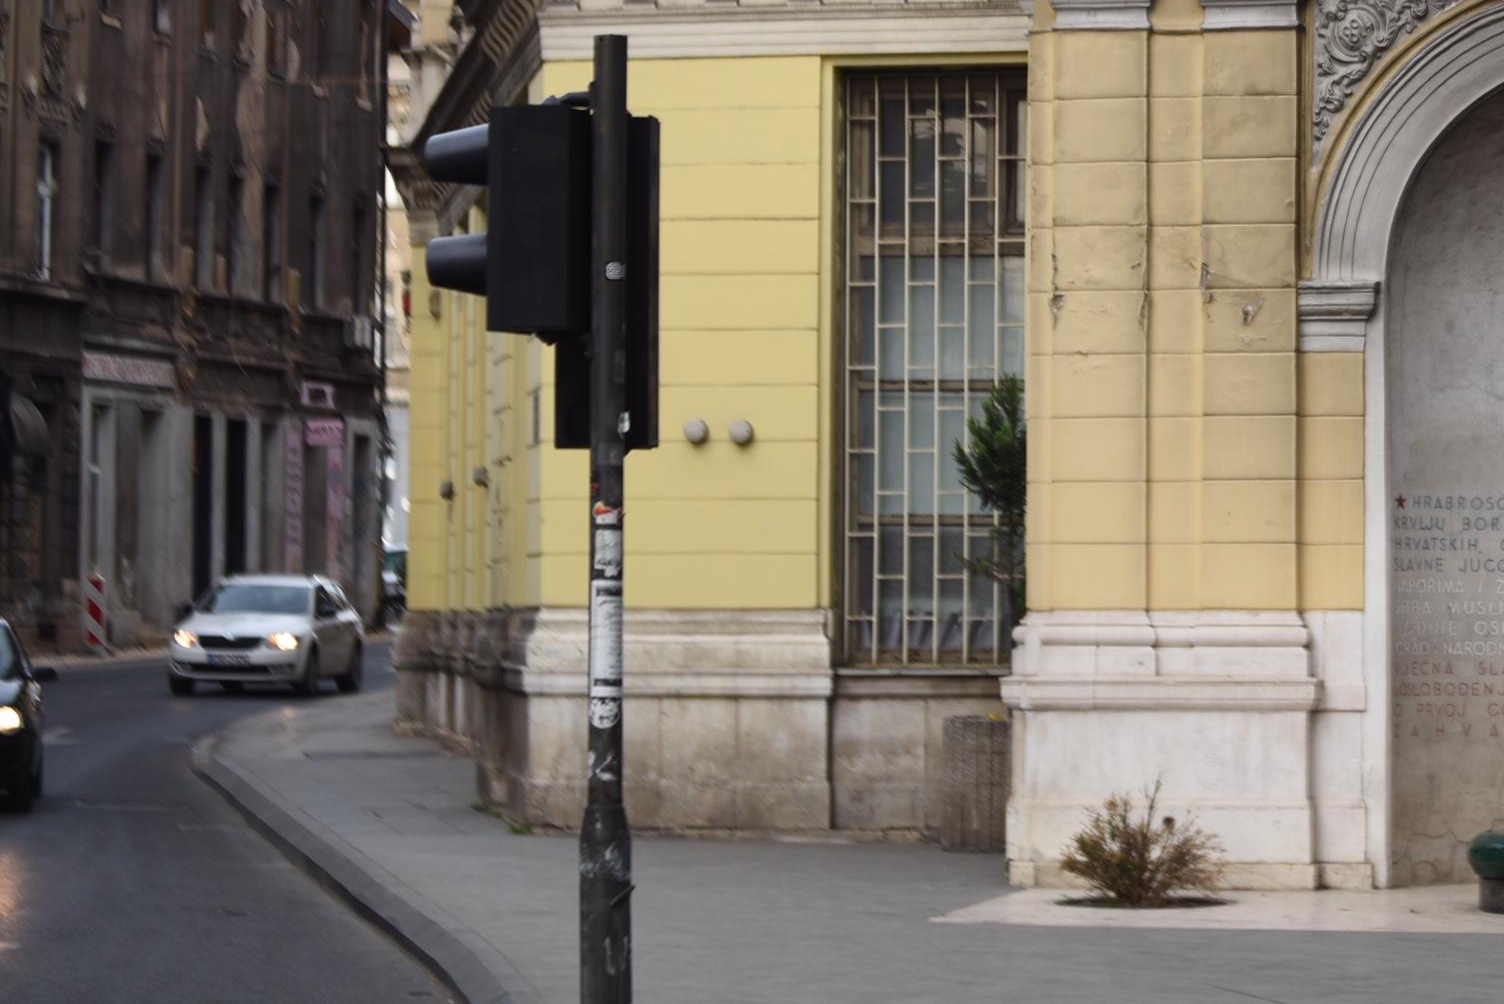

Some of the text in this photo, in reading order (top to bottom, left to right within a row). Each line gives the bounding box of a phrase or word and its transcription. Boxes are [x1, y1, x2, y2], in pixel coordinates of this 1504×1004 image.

[1393, 515, 1446, 532] KRVLJU
[1393, 558, 1443, 573] SLAVNE
[1416, 703, 1466, 717] PRVOJ
